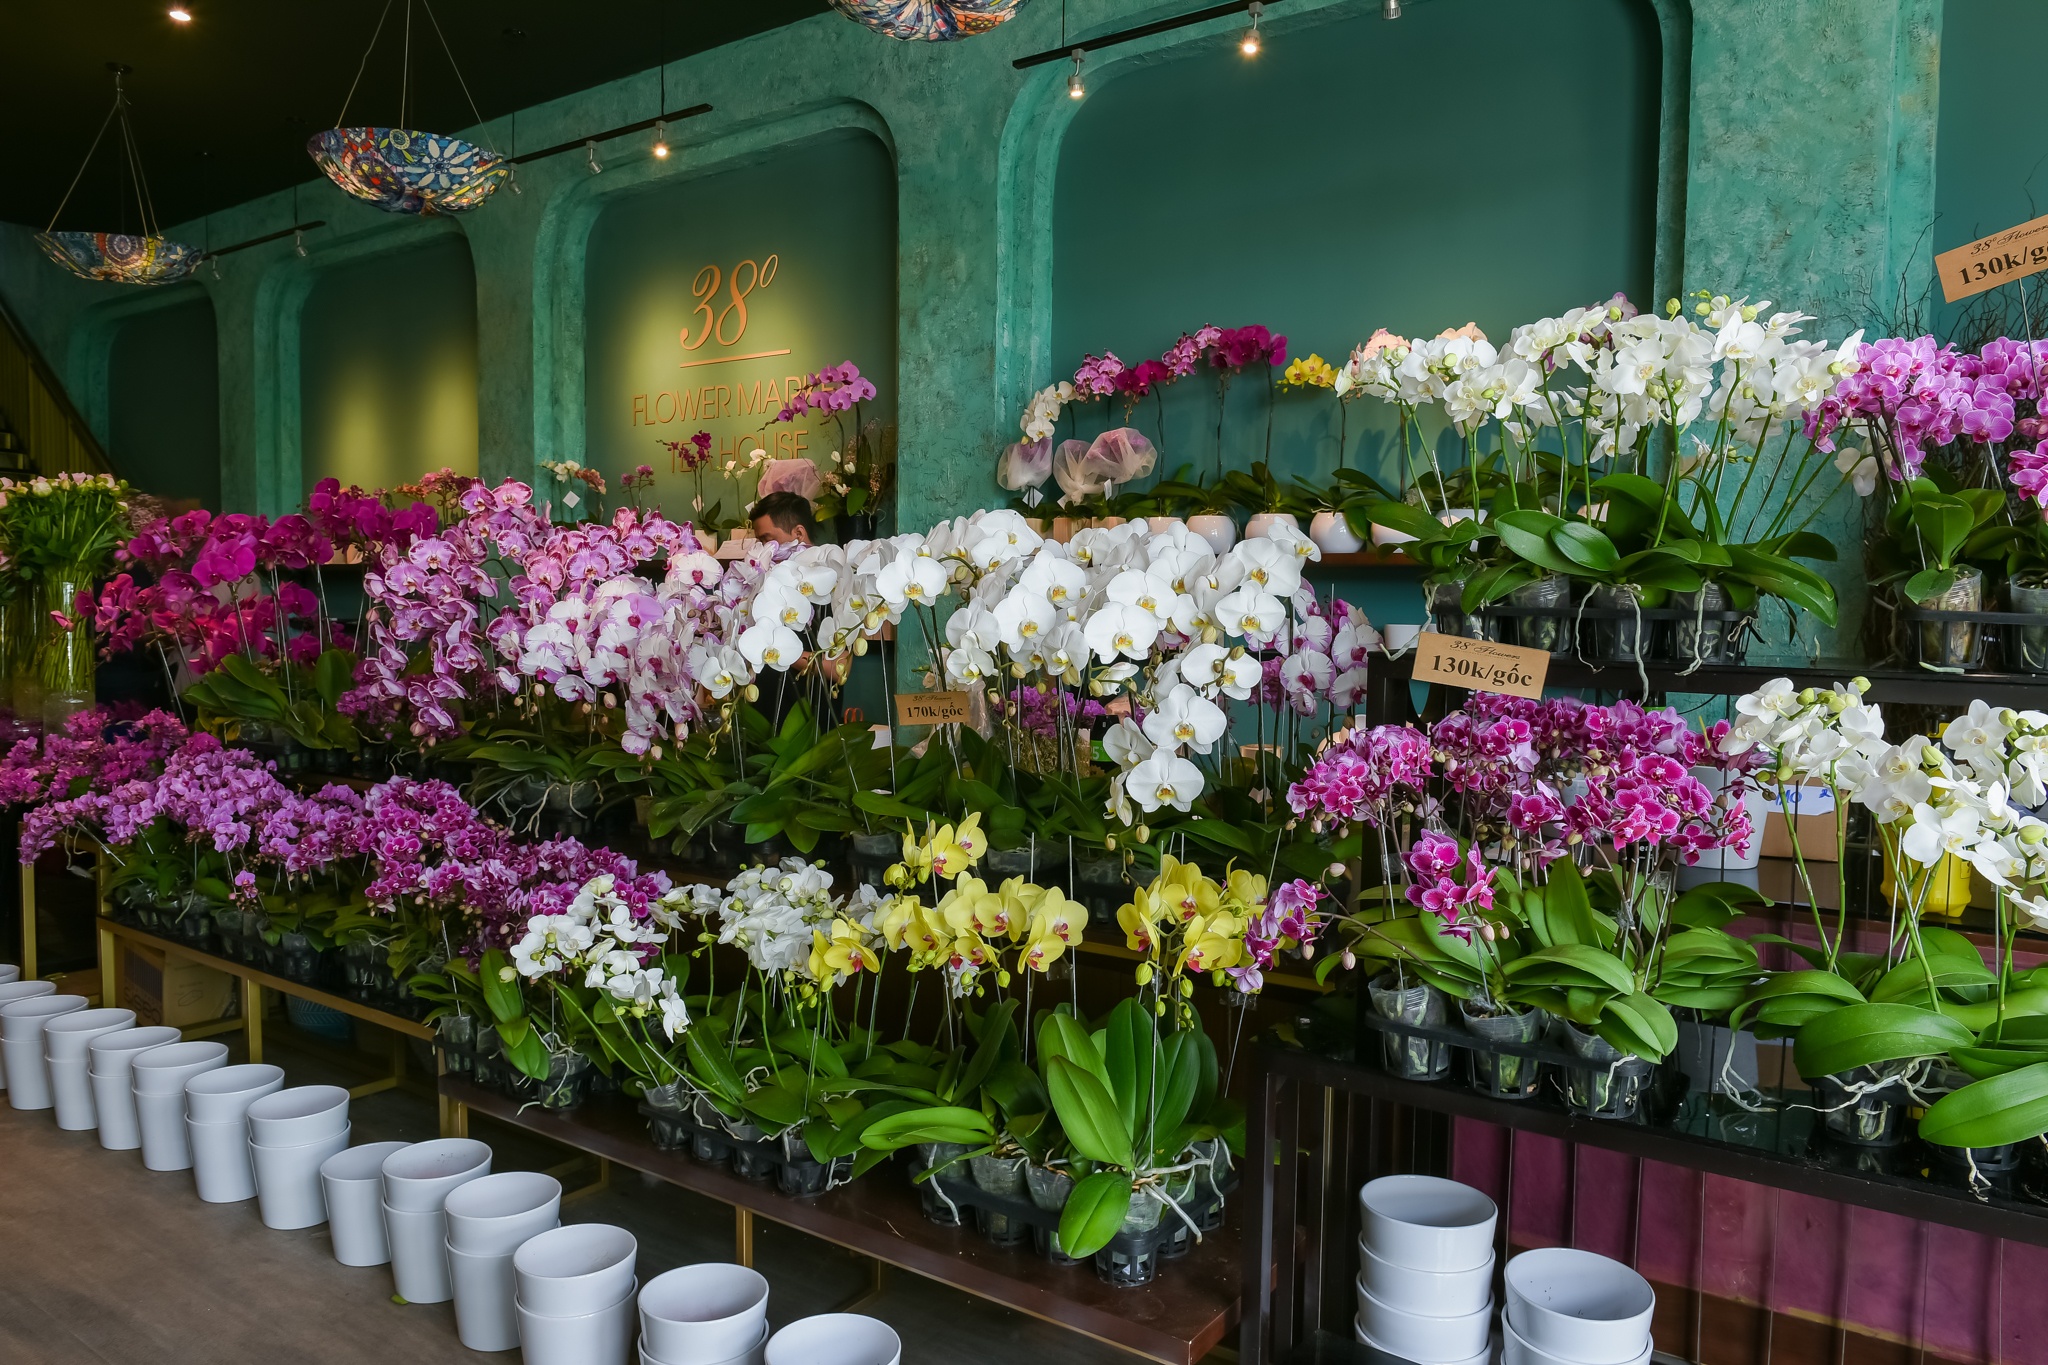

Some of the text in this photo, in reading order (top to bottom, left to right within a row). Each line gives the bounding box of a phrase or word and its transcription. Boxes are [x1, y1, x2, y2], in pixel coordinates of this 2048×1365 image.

[1958, 245, 2048, 286] 130k/g
[633, 372, 848, 426] FLOWER MAR
[1474, 645, 1521, 660] Flowers
[1431, 654, 1533, 687] 130k/gốc
[907, 702, 964, 720] 170k/gốc
